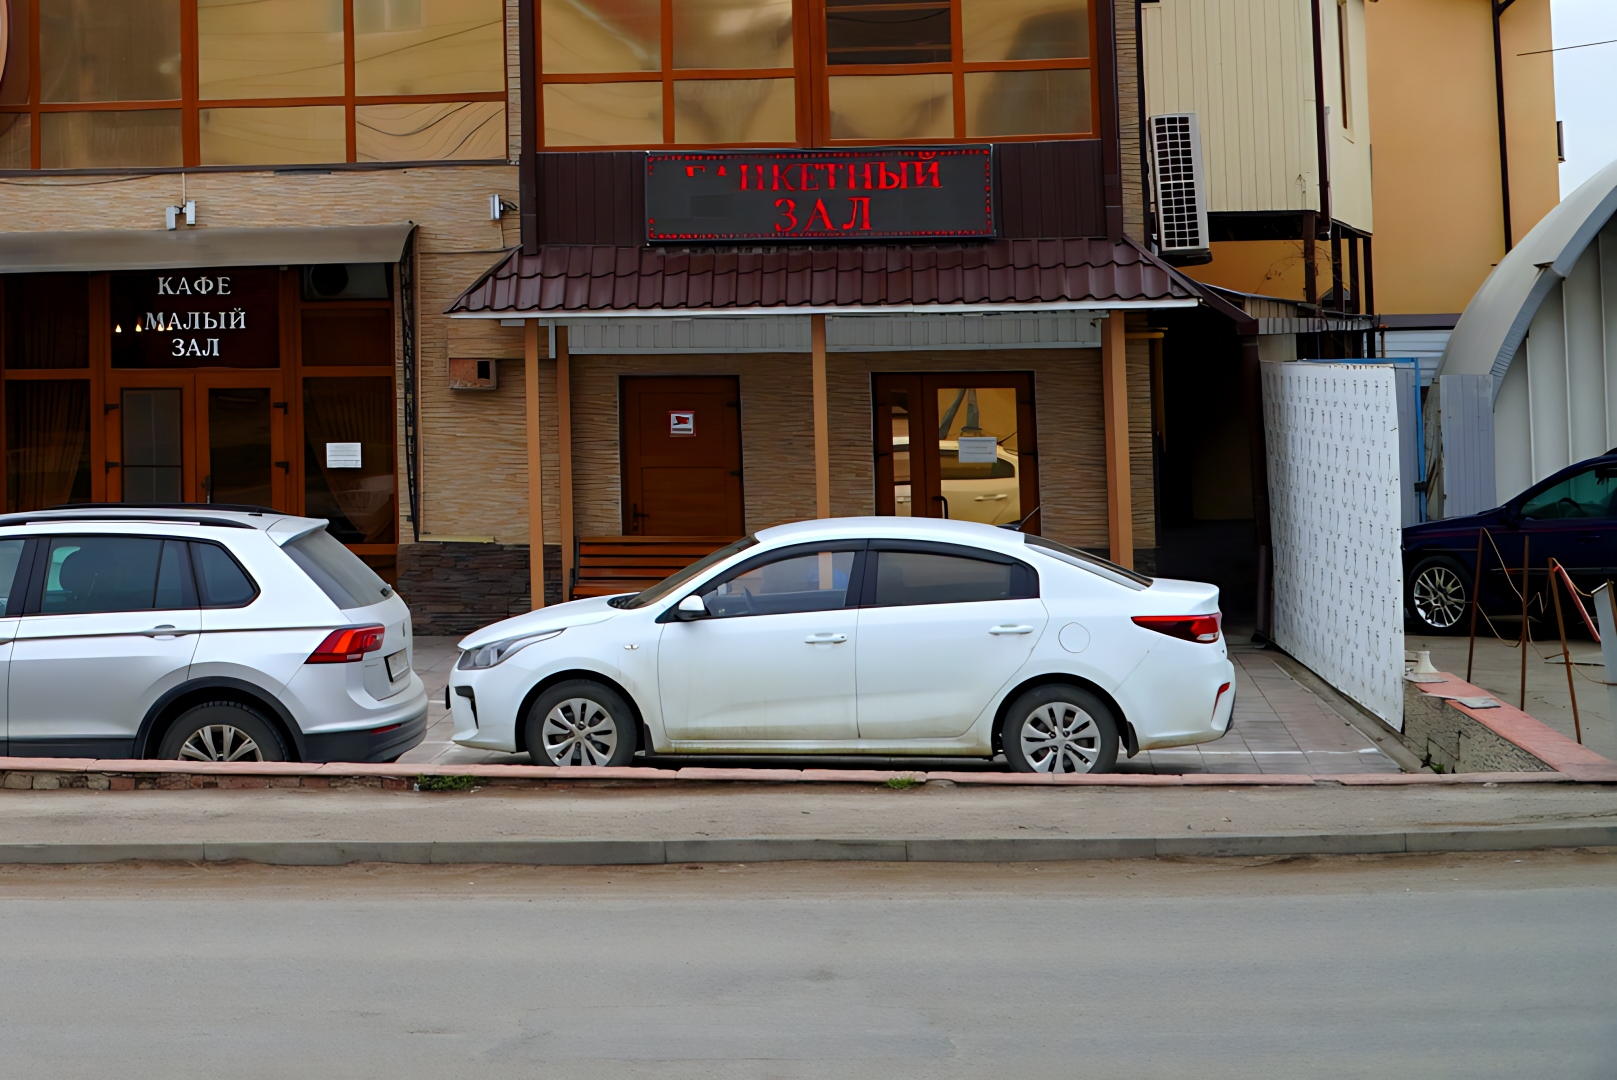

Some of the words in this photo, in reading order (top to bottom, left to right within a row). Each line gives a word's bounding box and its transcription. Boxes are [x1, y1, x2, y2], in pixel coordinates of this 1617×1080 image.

[685, 151, 943, 191] НКЕТНЫЙ
[774, 197, 872, 233] ЗАЛ
[157, 276, 231, 296] КАФЕ
[144, 307, 246, 331] МАЛЫЙ
[171, 338, 220, 357] ЗАЛ
